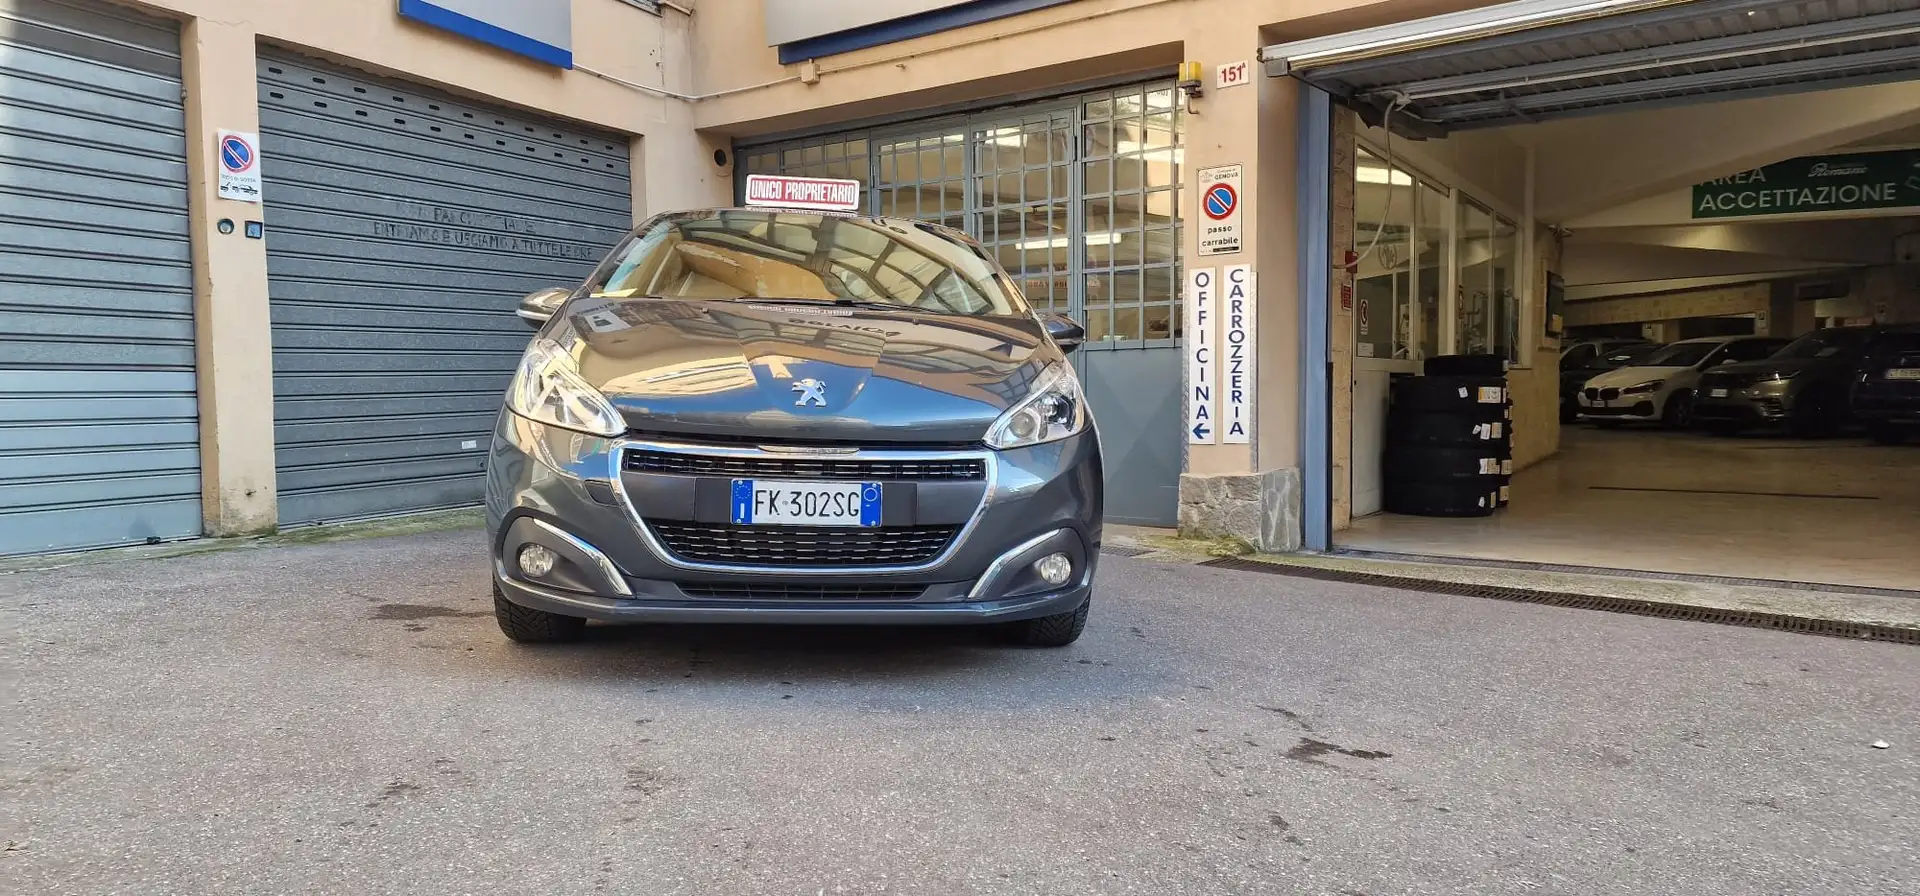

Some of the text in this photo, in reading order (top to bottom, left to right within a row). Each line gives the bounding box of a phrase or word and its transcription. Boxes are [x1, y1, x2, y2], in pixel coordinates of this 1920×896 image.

[1214, 172, 1239, 180] GENOVA
[751, 179, 855, 203] UNICO PROPRIETARIO
[1698, 182, 1898, 212] ACCETTAZIONE
[1201, 236, 1239, 247] carrabile
[1207, 225, 1233, 234] passo
[1195, 271, 1211, 420] OFFICINA
[1228, 268, 1246, 436] CARROZZERIA
[755, 489, 781, 516] FK
[789, 491, 861, 517] 302SG
